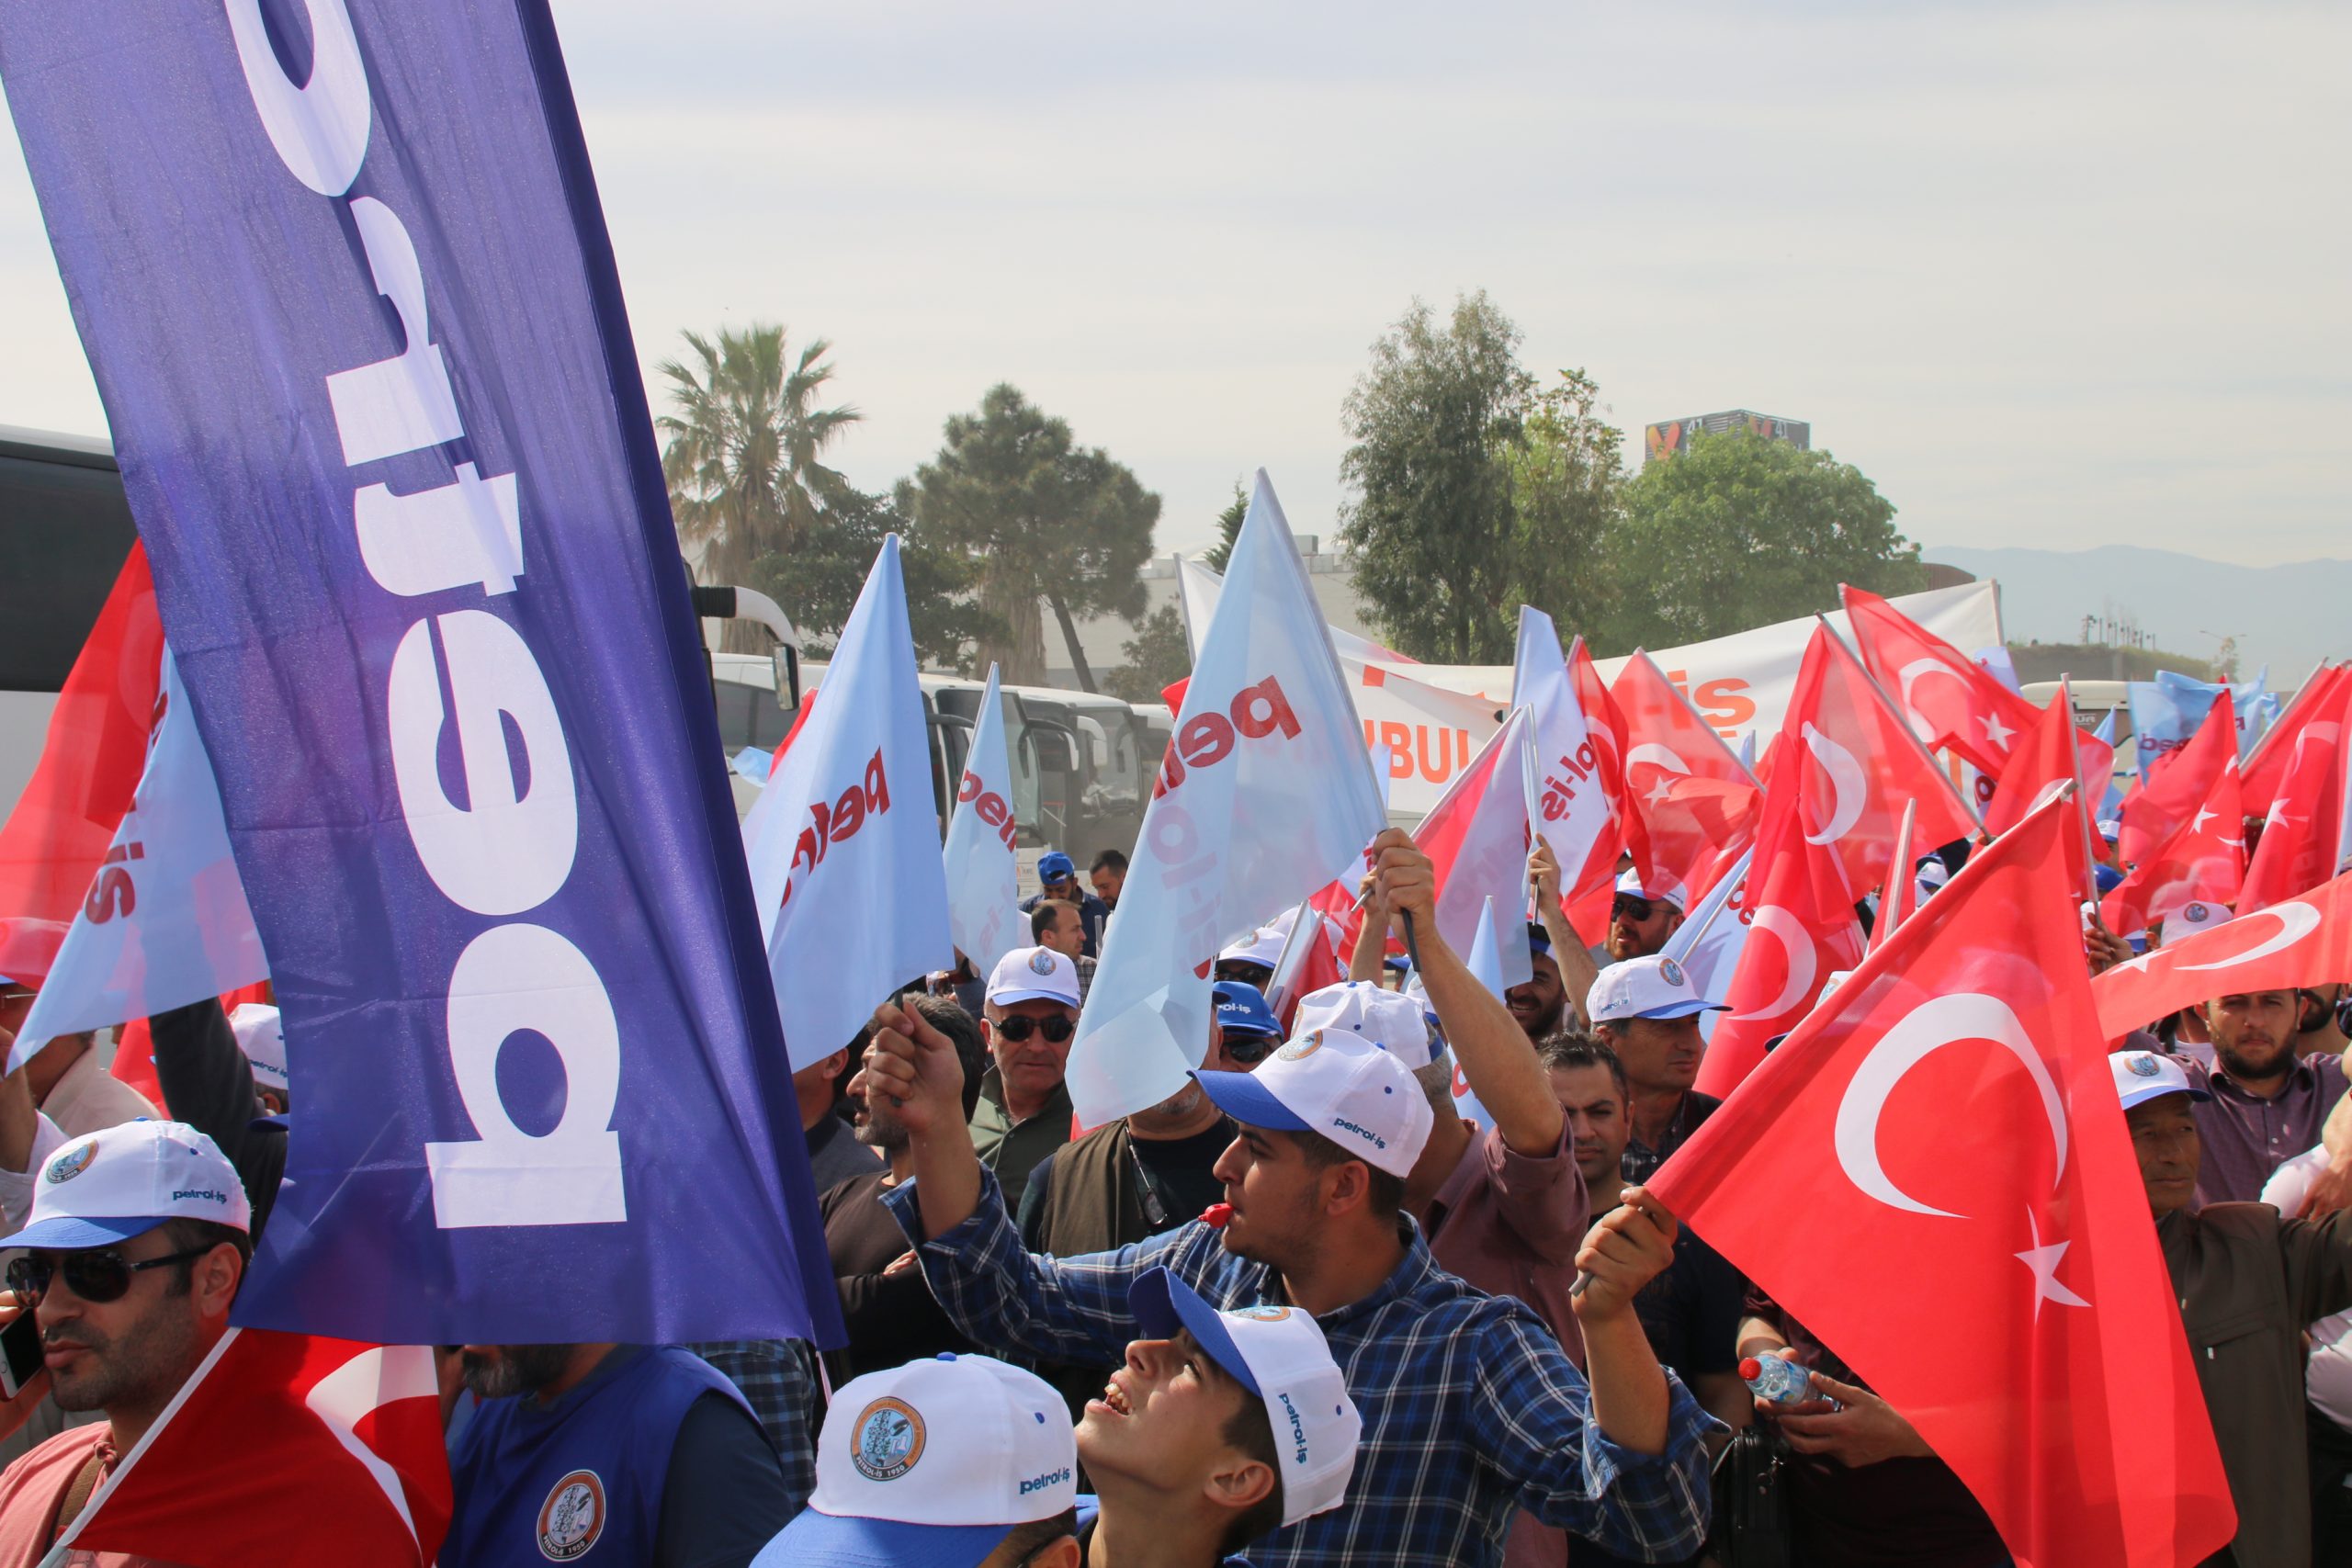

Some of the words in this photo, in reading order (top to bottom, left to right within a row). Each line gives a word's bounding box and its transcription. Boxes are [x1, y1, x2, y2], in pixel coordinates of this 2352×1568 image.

[1333, 1117, 1386, 1149] petrol-iş
[172, 1189, 228, 1204] petrol-iş
[1278, 1393, 1308, 1464] petrol-iş
[1019, 1467, 1070, 1495] petrol-iş
